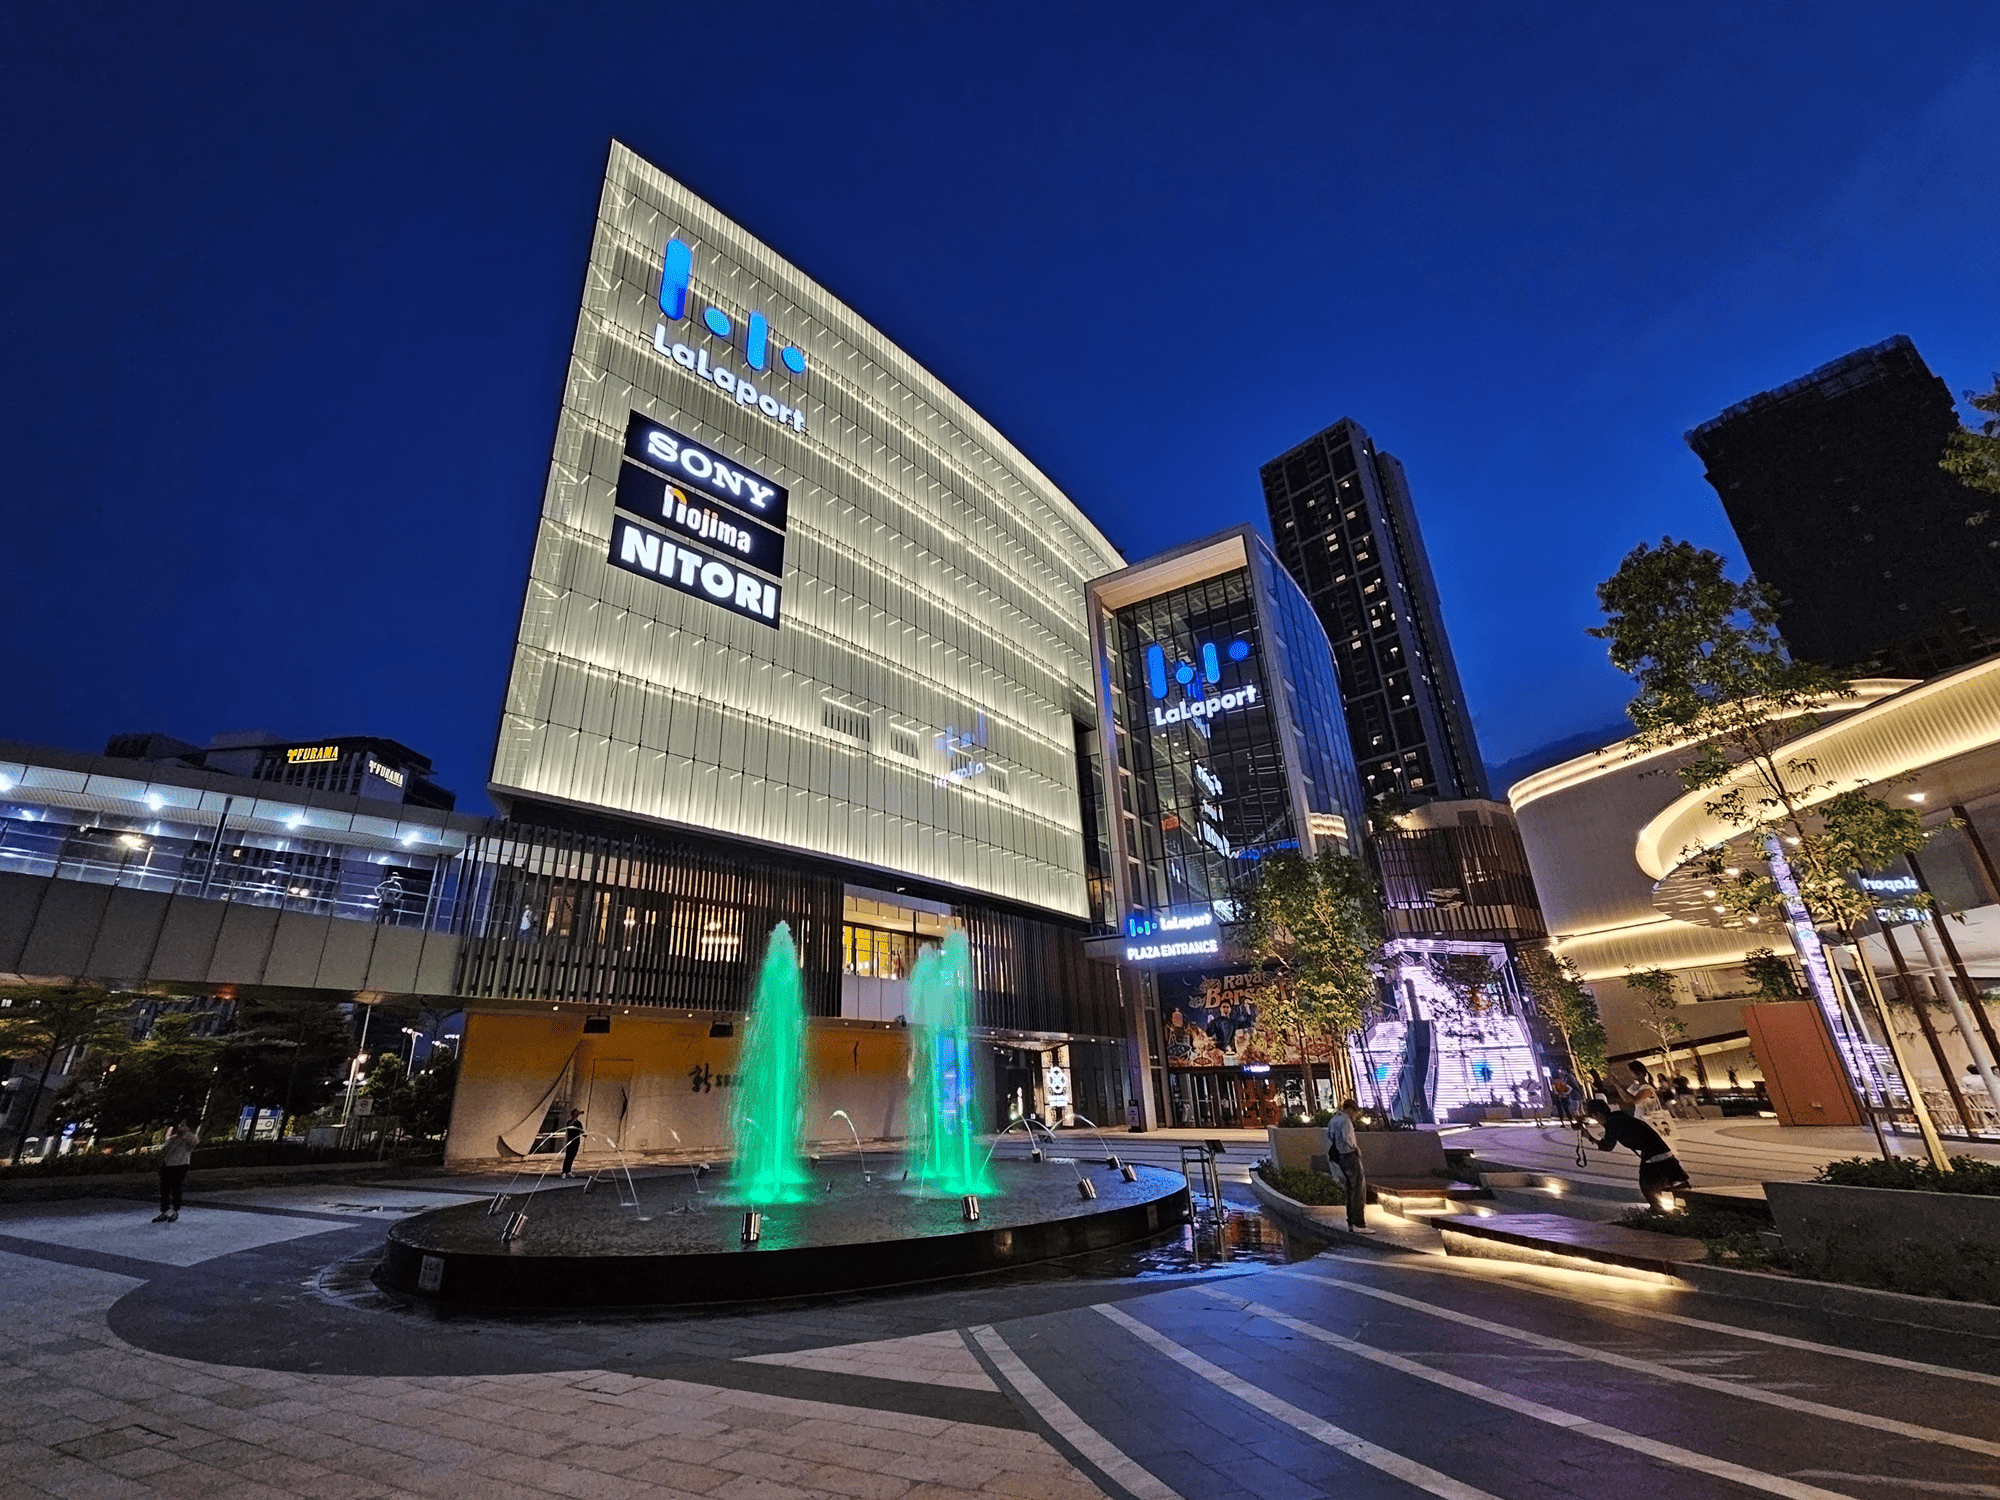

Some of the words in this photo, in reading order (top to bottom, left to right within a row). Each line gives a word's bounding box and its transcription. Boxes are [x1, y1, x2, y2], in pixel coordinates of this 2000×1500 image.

[653, 323, 805, 431] LaLaport
[648, 431, 774, 508] SONY
[662, 484, 751, 553] nojima
[621, 526, 776, 619] NITORI
[1154, 684, 1257, 726] LaLaport
[296, 746, 339, 760] FURAMA
[375, 763, 404, 785] FURAMA
[1160, 913, 1213, 931] LaLaport
[1127, 945, 1161, 960] PLAZA
[1160, 939, 1219, 957] ENTRANCE
[1223, 972, 1262, 990] Raya
